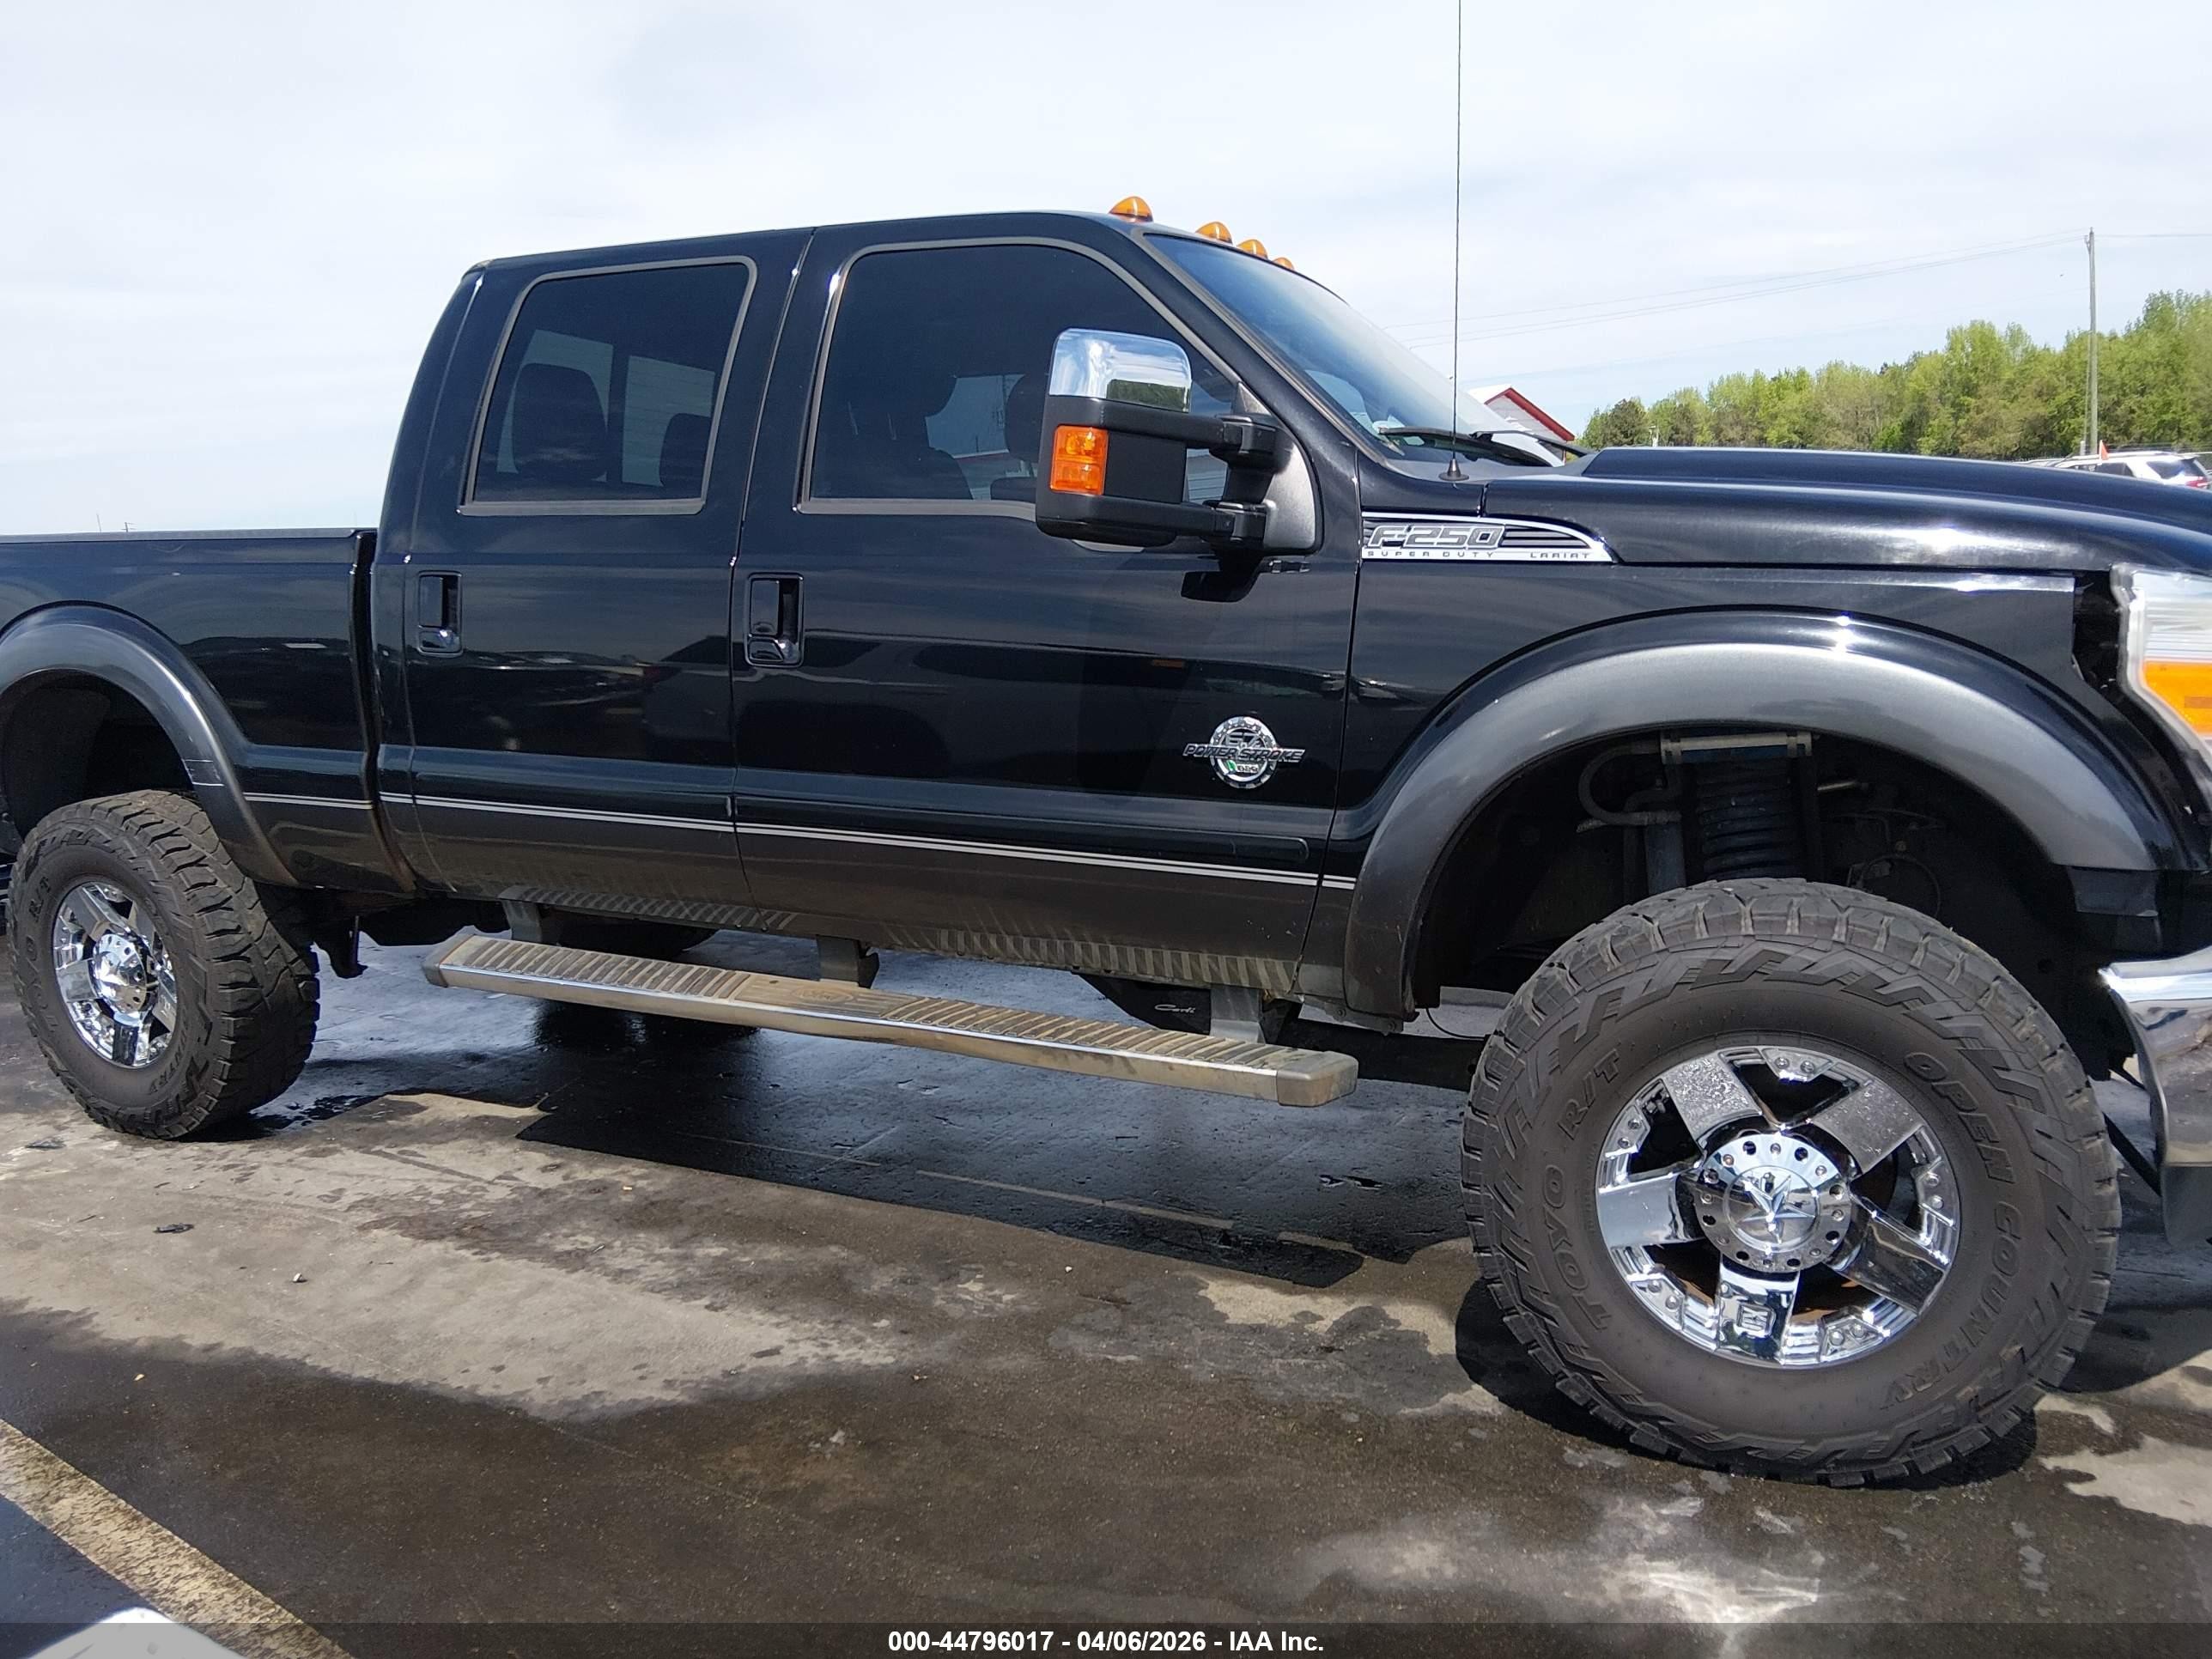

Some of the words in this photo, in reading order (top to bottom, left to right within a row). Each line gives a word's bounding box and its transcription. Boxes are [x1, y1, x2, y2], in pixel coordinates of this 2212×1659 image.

[1182, 744, 1237, 759] POWER
[1237, 748, 1305, 763] STROKE
[1556, 1048, 1620, 1140] R/T
[1903, 1052, 2016, 1184] OPEN
[1543, 1164, 1612, 1330] TOYO
